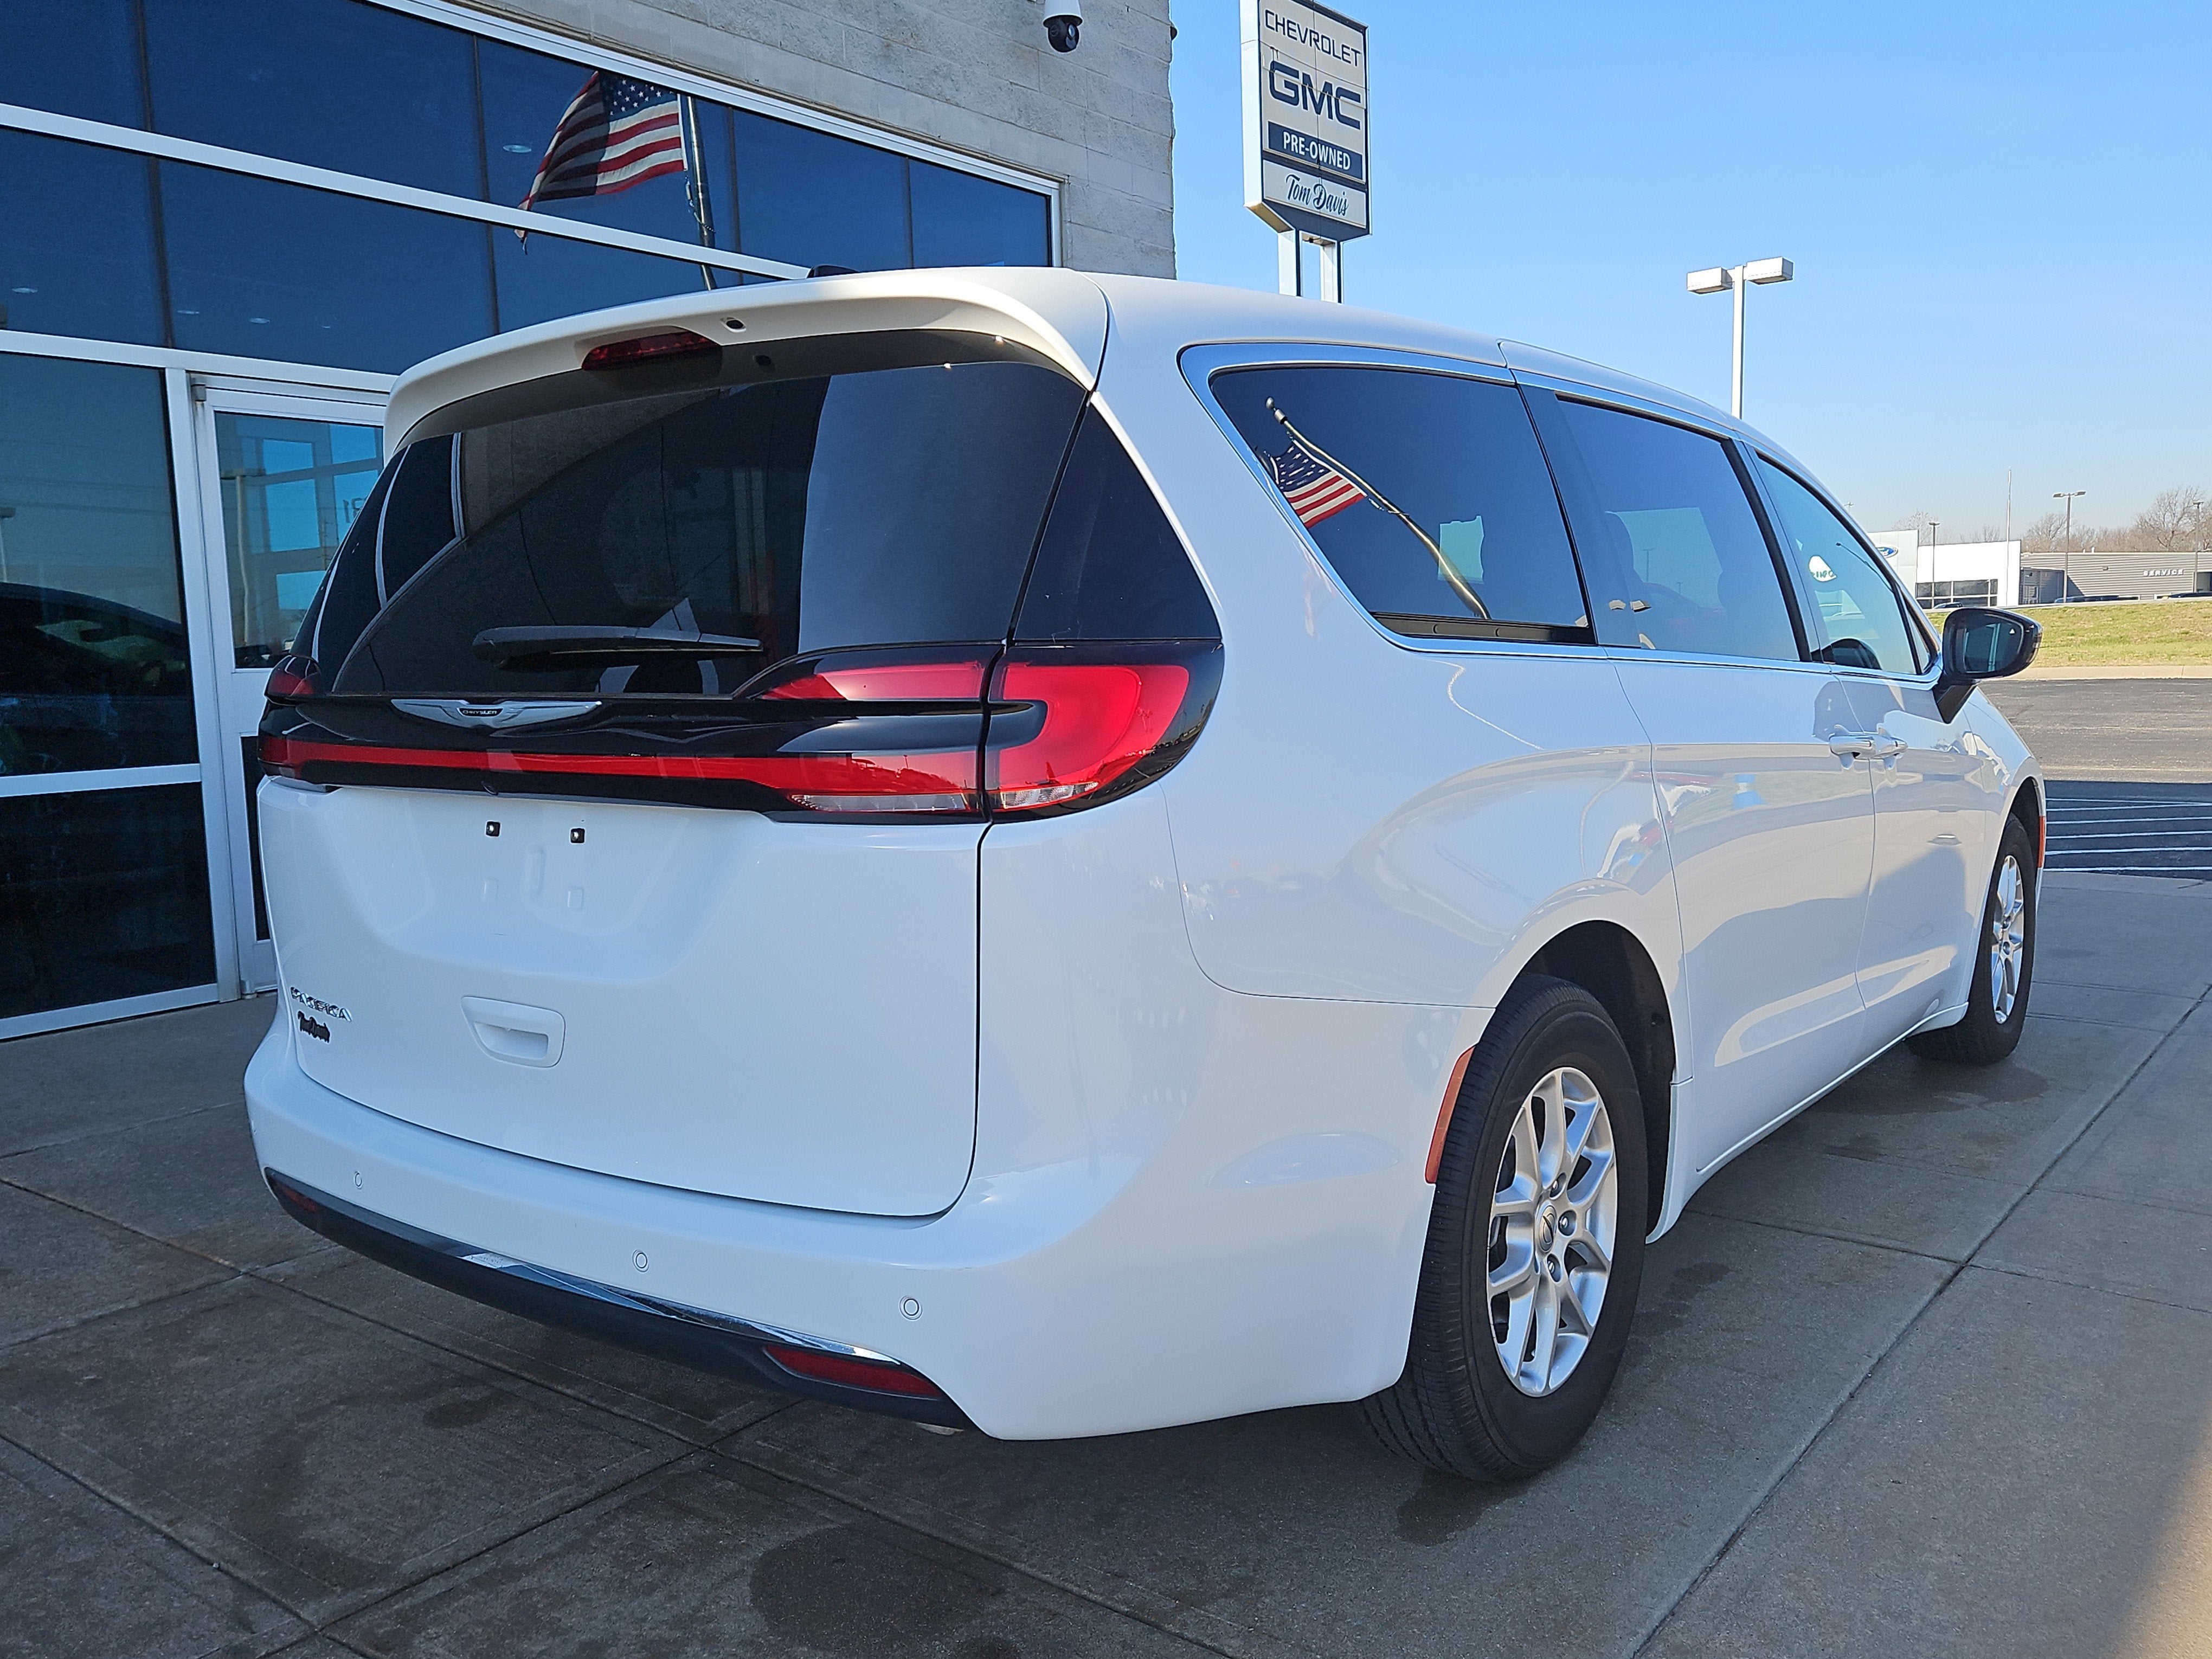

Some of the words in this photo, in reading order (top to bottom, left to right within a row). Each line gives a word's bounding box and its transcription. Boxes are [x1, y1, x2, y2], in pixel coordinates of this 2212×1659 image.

[1265, 9, 1360, 66] CHEVROLET
[1269, 60, 1361, 130] GMC
[1283, 131, 1351, 170] PRE-OWNED
[1285, 174, 1314, 204] Tom
[1313, 183, 1349, 216] Davis
